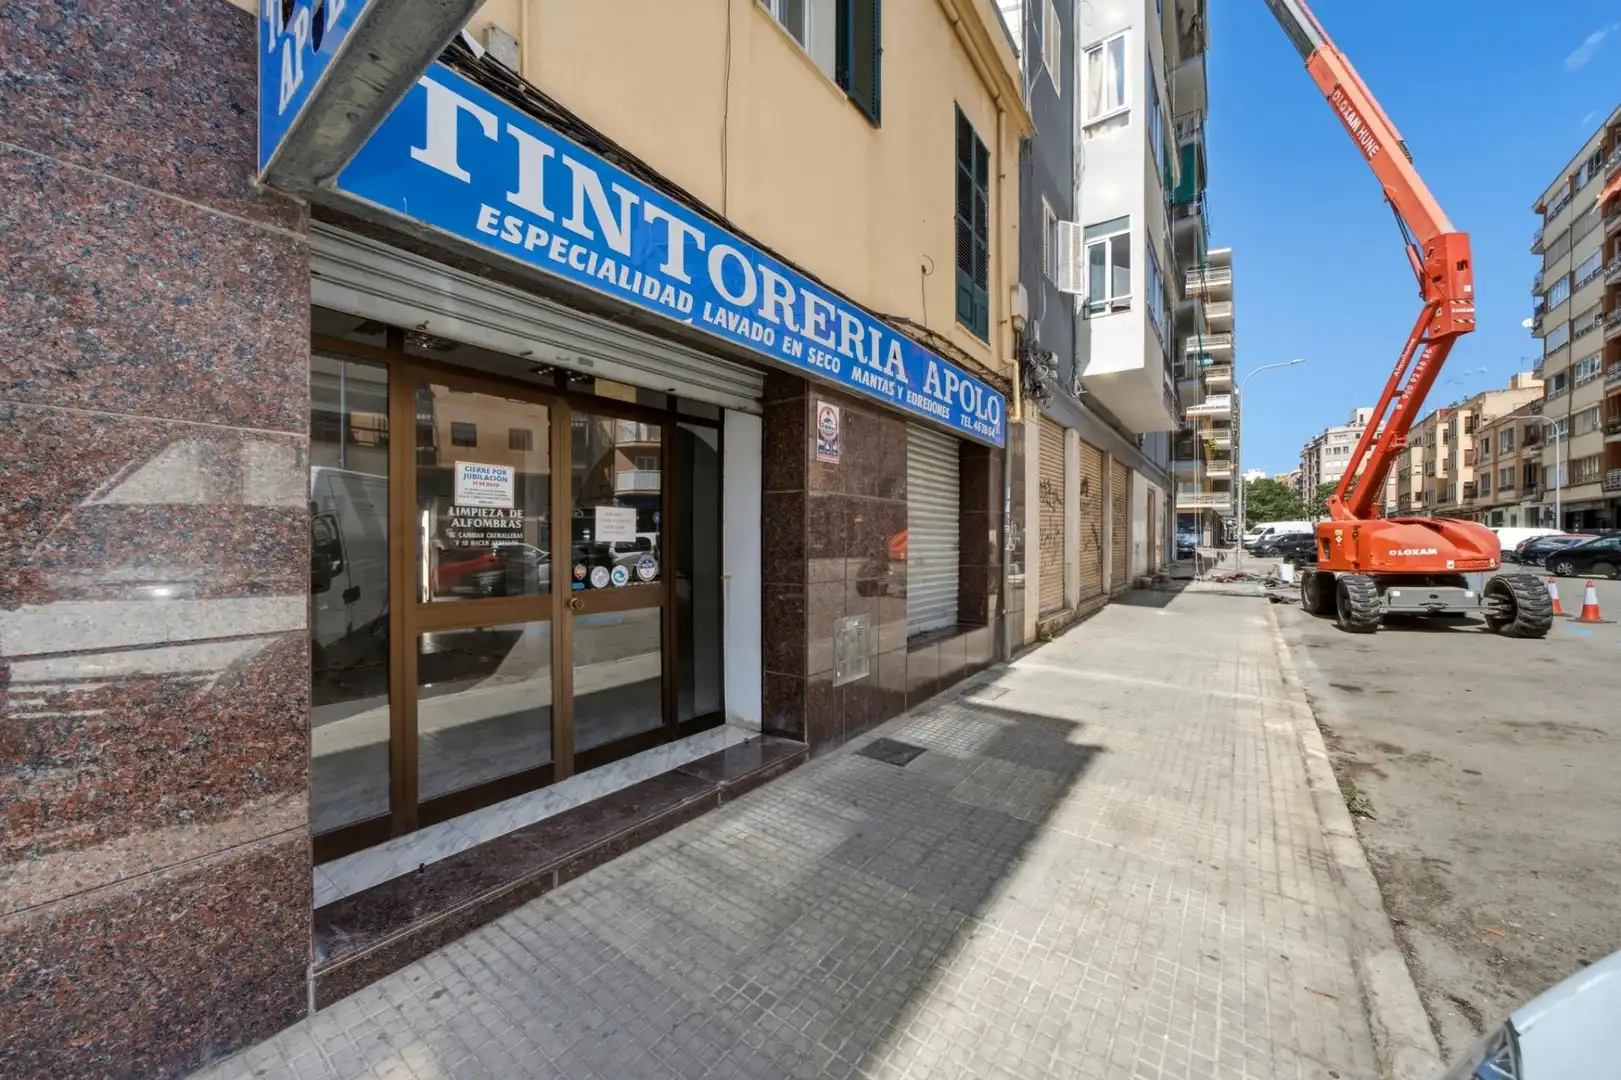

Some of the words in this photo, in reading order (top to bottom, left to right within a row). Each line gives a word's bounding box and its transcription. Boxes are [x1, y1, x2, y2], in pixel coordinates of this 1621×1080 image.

[1356, 126, 1380, 158] HUNE
[410, 75, 909, 384] TINTORERIA
[923, 360, 1001, 425] APOLO
[476, 203, 695, 321] ESPECIALIDAD
[702, 300, 775, 347] LAVADO
[782, 335, 803, 358] EN
[807, 347, 841, 374] SECO
[851, 366, 896, 397] MANTAS
[897, 385, 904, 400] Y
[906, 389, 950, 420] EDREDONES
[464, 465, 491, 474] CIERRE
[492, 467, 508, 476] POR
[448, 506, 504, 518] LIMPIEZA
[509, 509, 524, 519] DE
[451, 518, 522, 529] ALFOMBRAS
